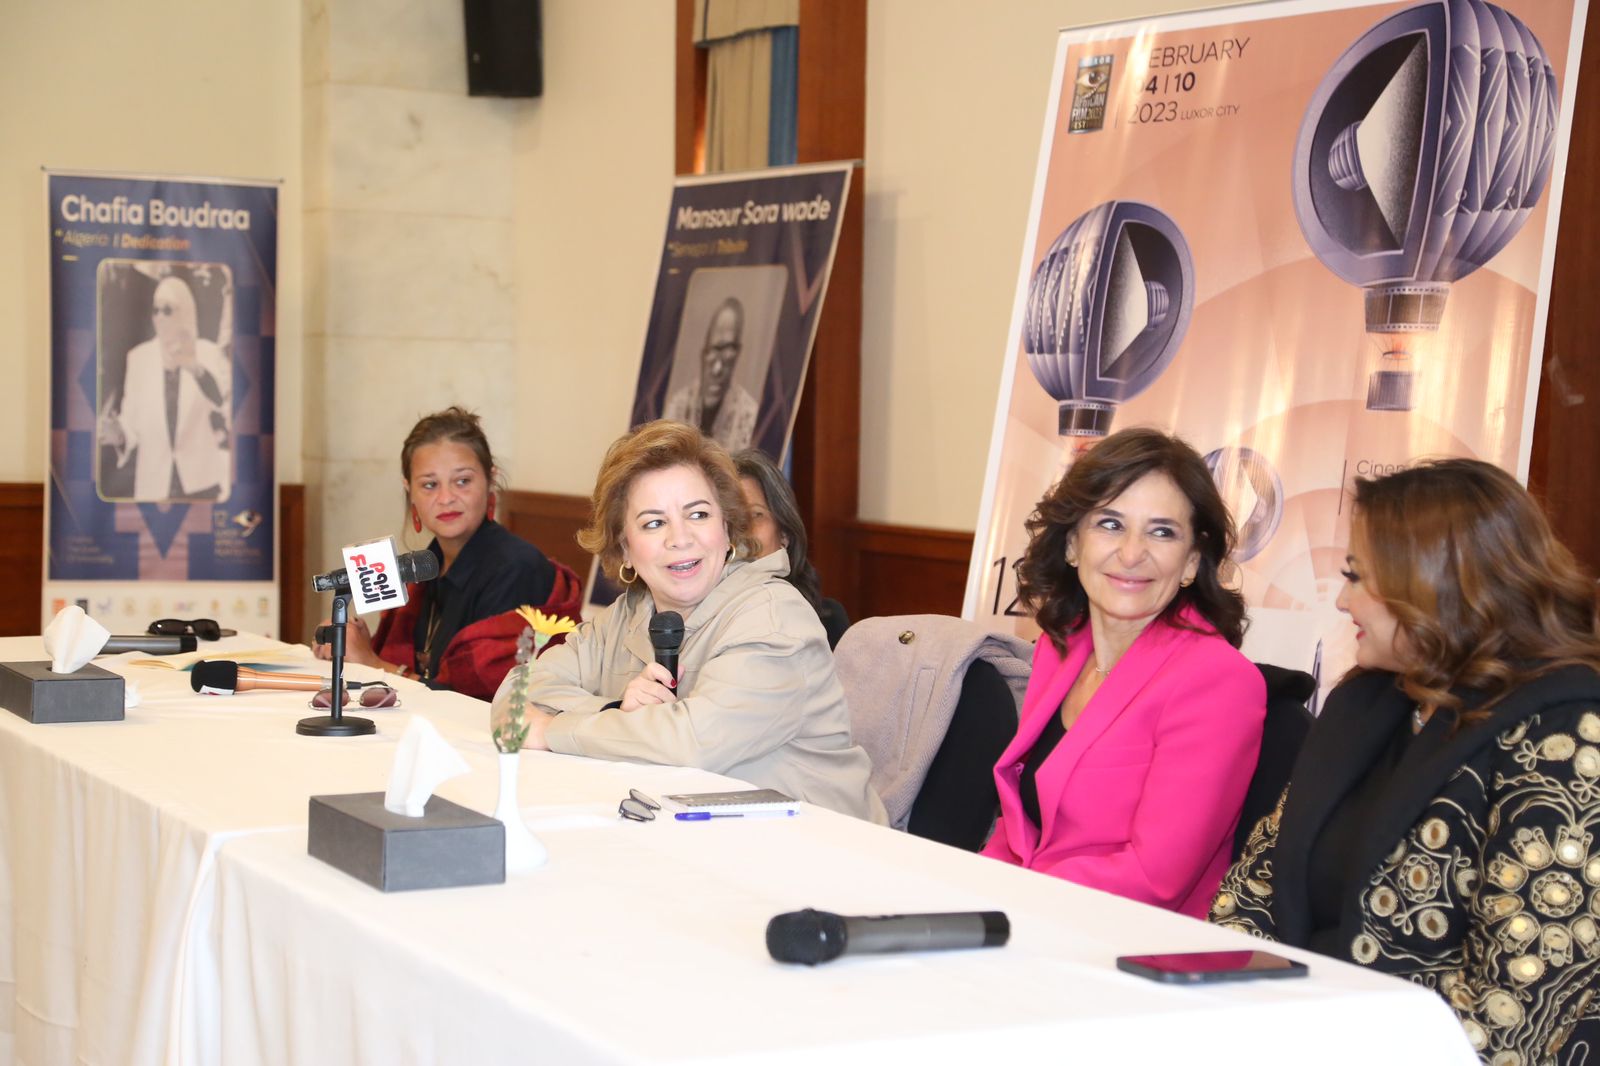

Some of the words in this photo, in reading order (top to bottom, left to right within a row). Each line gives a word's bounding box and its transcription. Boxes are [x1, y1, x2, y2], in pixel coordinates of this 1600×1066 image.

[1127, 37, 1250, 69] EBRUARY
[1136, 75, 1158, 95] 4
[1175, 71, 1196, 92] 10
[1127, 101, 1178, 124] 2023
[1180, 107, 1213, 121] LUXOR
[1215, 105, 1240, 117] CITY
[61, 194, 145, 225] Chafia
[149, 199, 250, 230] Boudraa
[676, 206, 742, 230] Mansour
[741, 201, 779, 225] Sora
[782, 194, 831, 222] wade
[349, 554, 381, 604] السابع
[369, 561, 397, 601] اليوم
